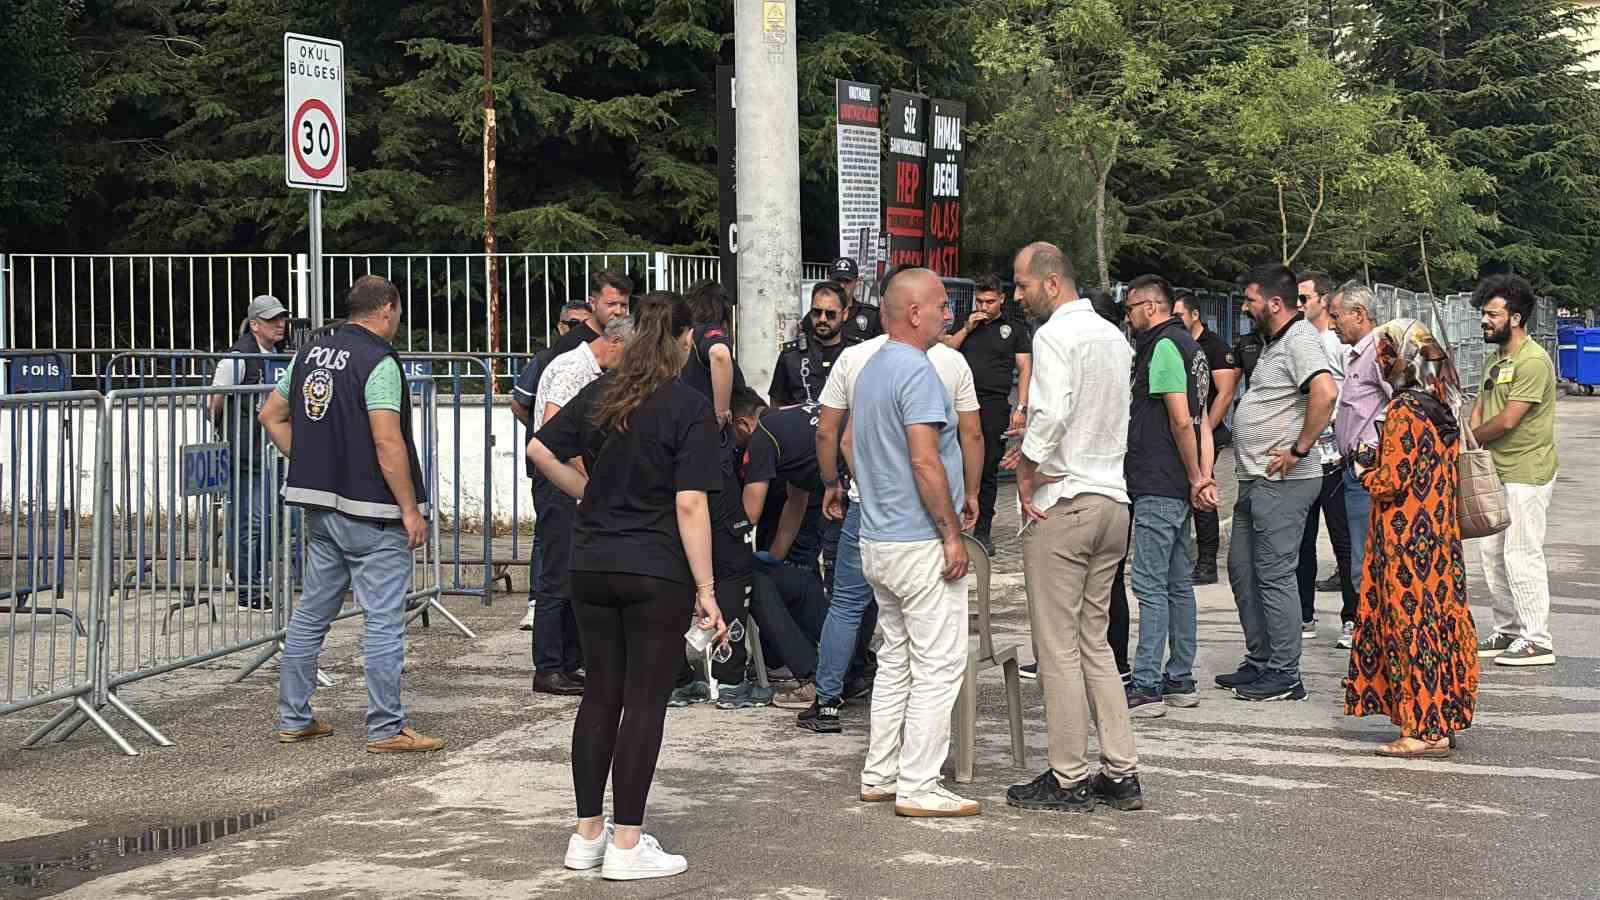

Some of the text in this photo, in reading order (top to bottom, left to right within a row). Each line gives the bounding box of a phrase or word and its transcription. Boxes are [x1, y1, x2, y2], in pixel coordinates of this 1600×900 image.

[290, 60, 340, 81] BÖLGESİ
[300, 45, 330, 62] OKUL
[904, 99, 917, 135] SİZ
[933, 105, 962, 151] İHMAL
[302, 120, 331, 157] 30
[896, 160, 920, 204] HEP
[932, 154, 960, 197] DEĞİL
